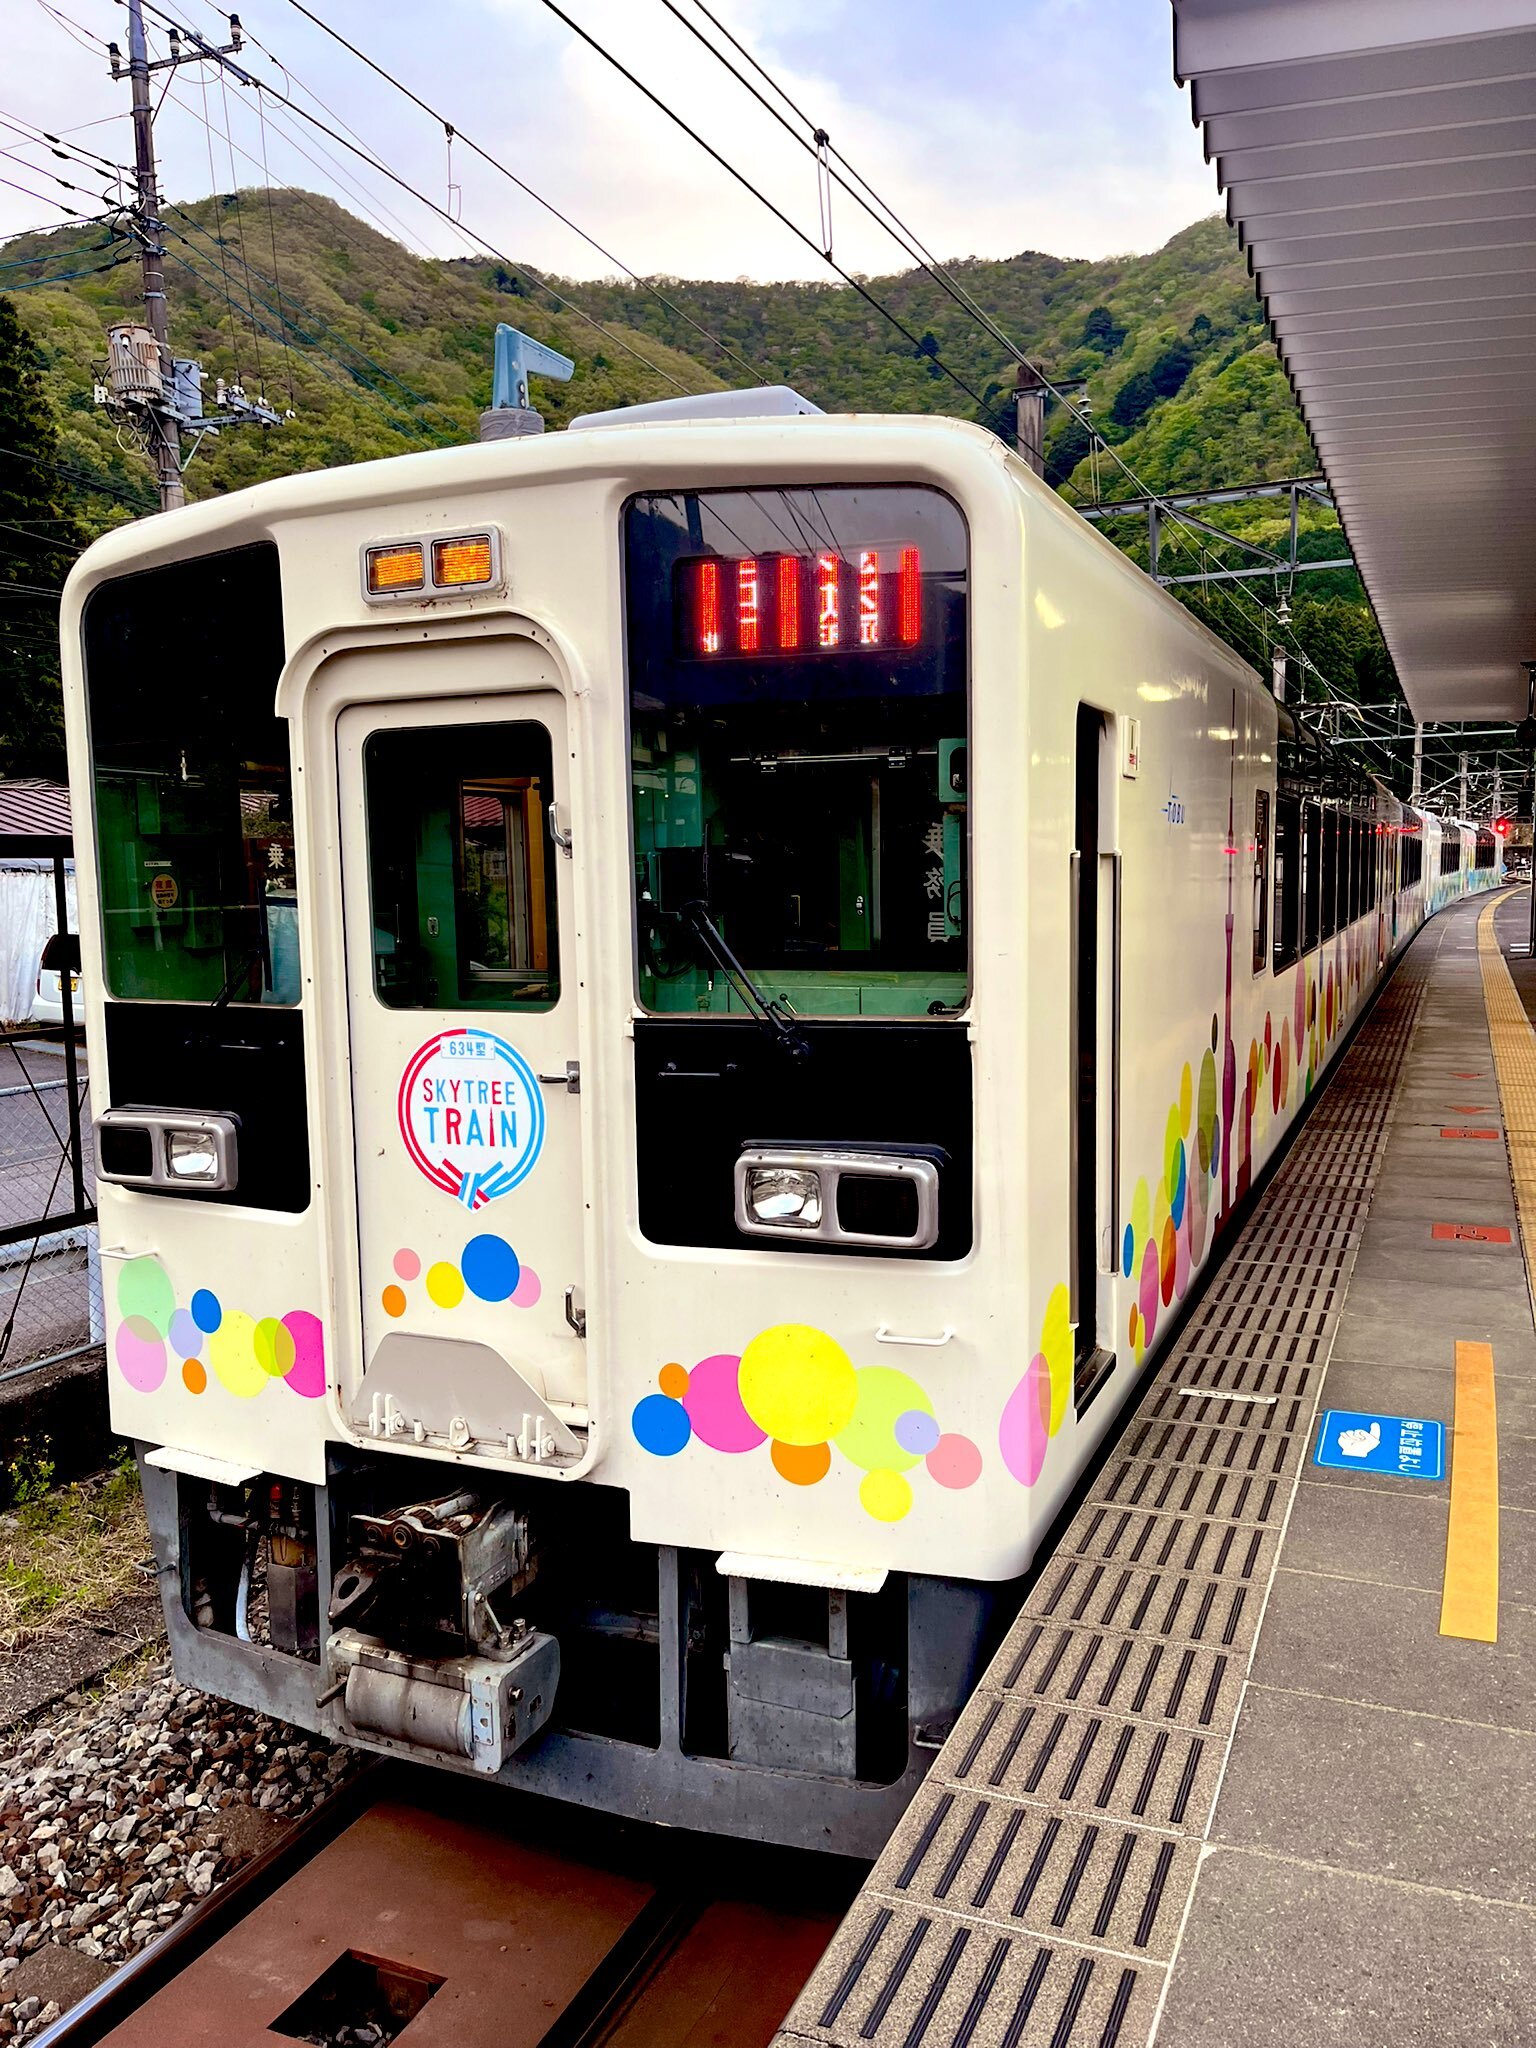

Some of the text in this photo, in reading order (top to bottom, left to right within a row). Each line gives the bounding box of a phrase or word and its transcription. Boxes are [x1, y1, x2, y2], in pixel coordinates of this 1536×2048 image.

[449, 1041, 486, 1057] 634型
[423, 1078, 516, 1106] SKYTREE
[423, 1107, 518, 1148] TRAIN
[1398, 1420, 1424, 1472] 停止位置よし
